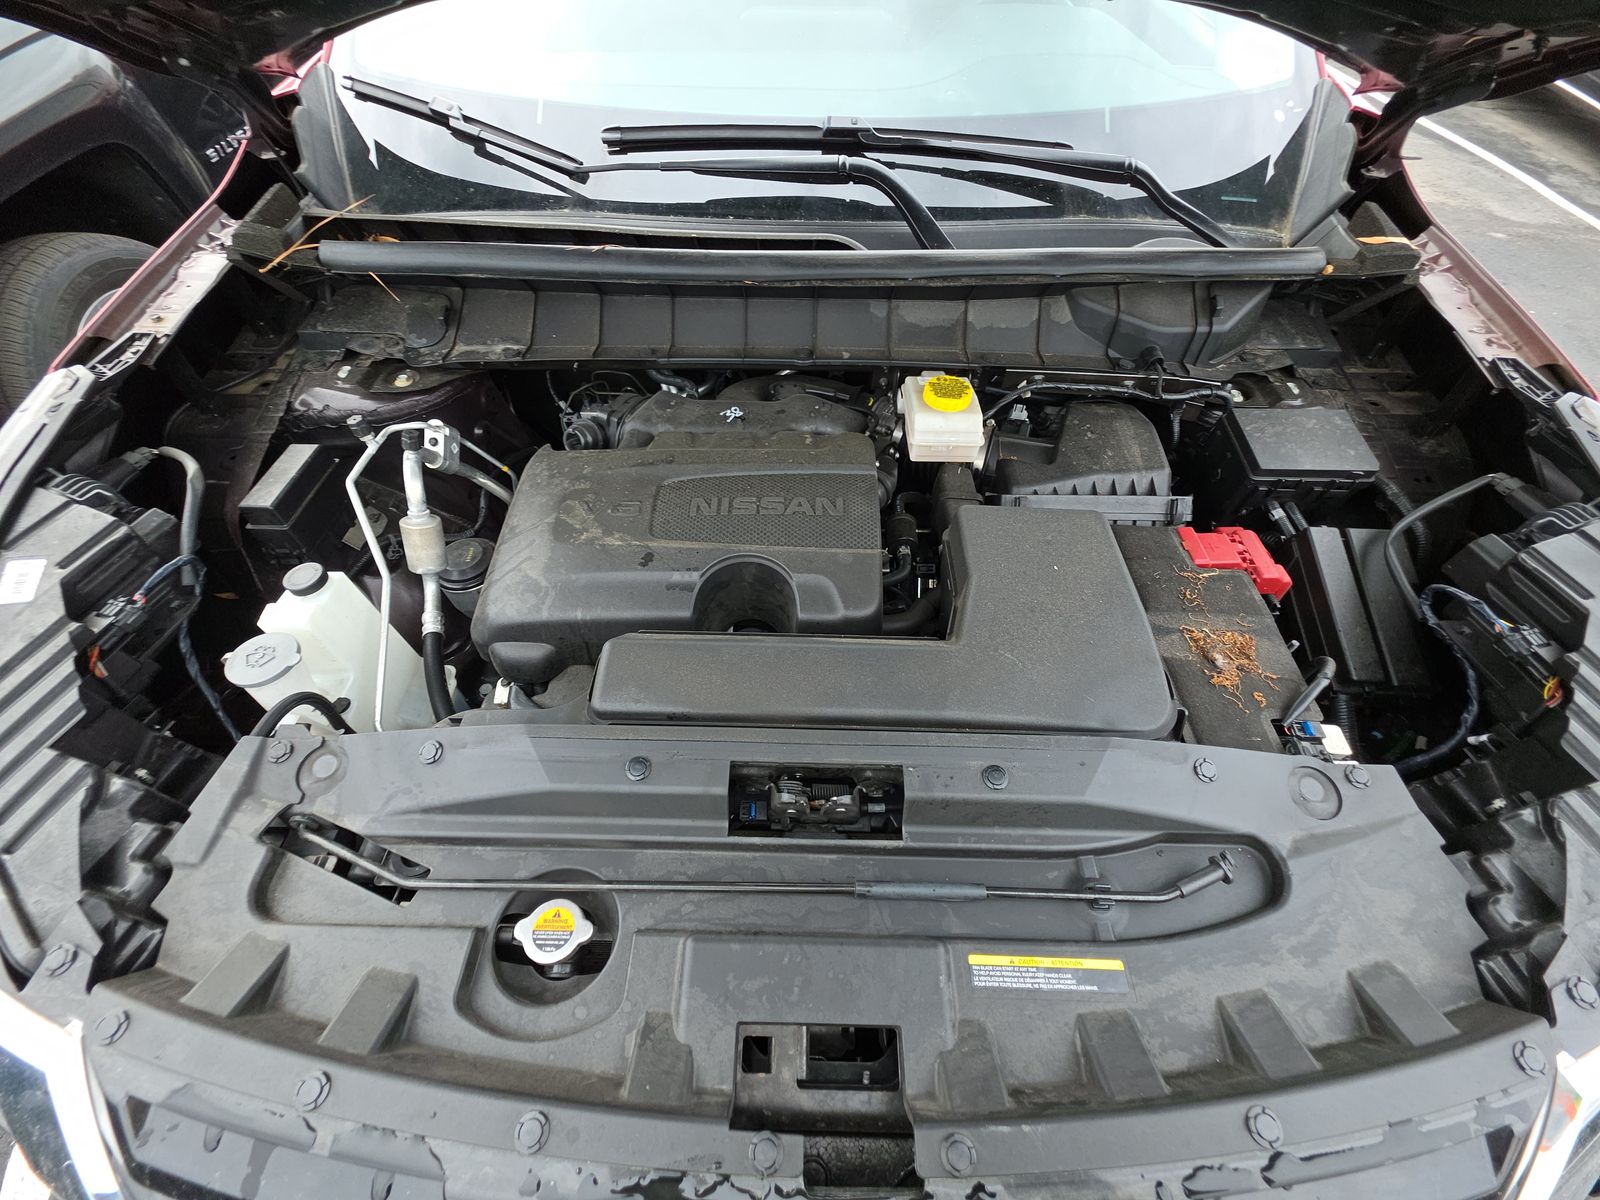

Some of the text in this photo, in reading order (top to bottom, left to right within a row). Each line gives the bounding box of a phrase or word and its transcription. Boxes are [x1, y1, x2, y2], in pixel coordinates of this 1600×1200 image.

[689, 496, 844, 516] NISSAN
[1018, 958, 1045, 966] CAUTION
[1051, 959, 1084, 967] ATTENTION
